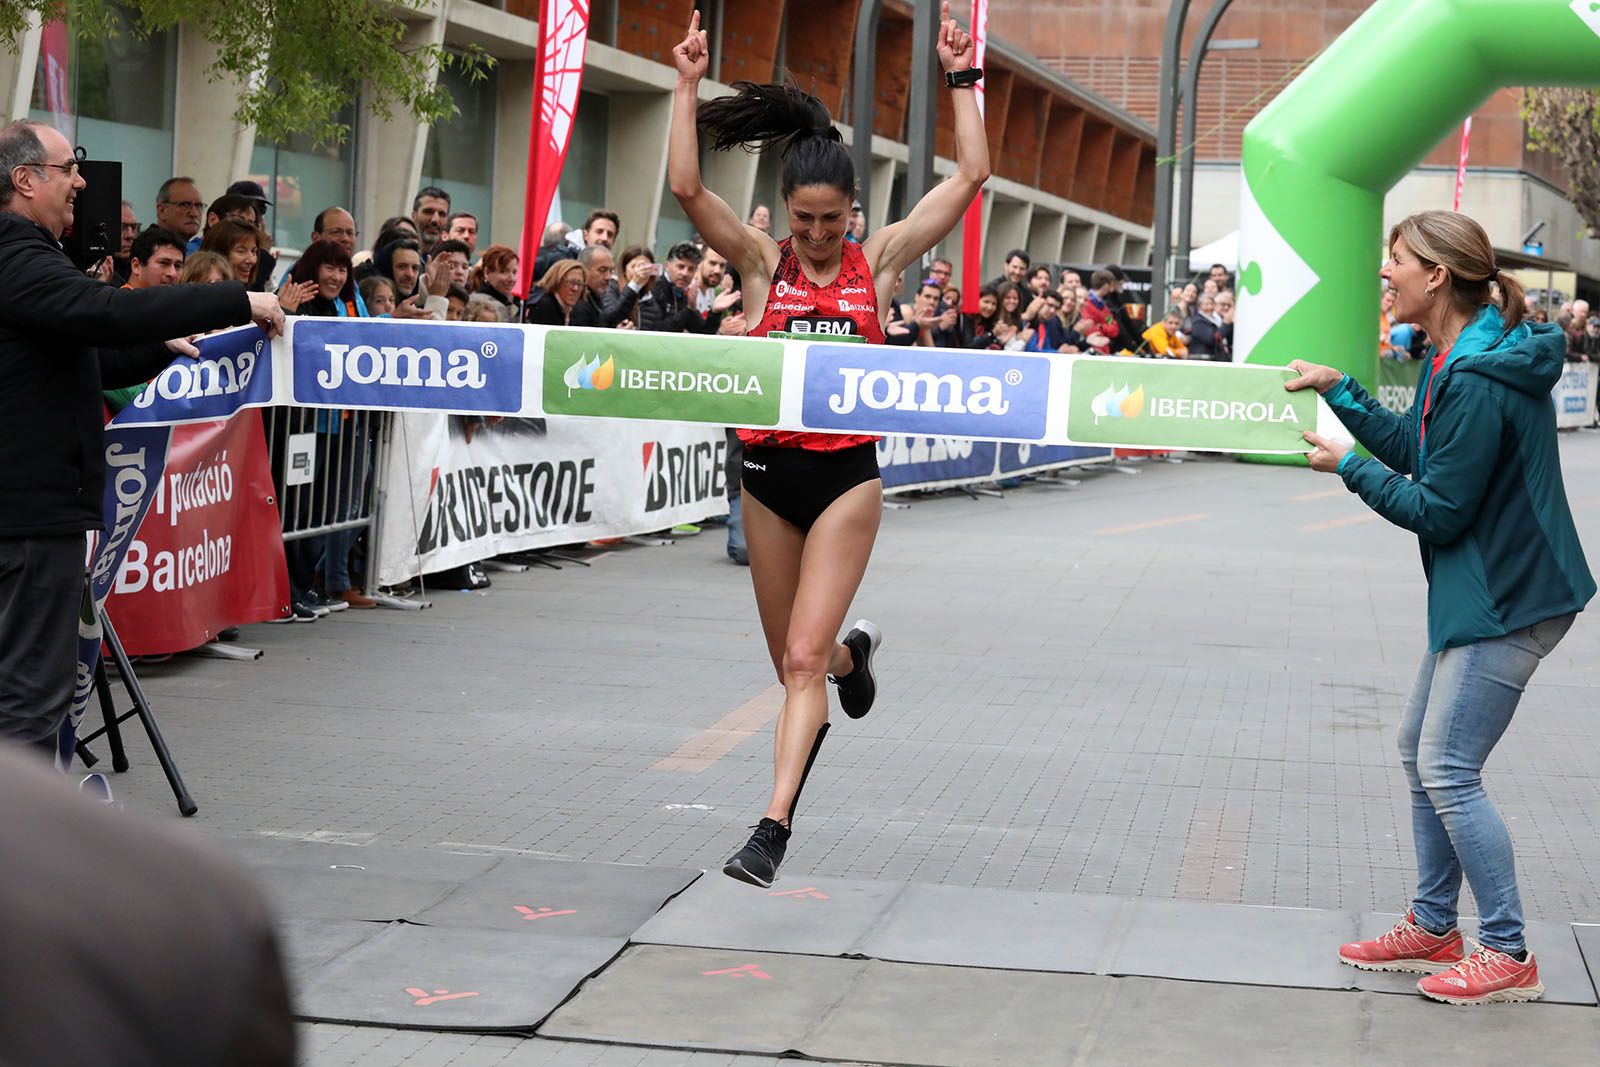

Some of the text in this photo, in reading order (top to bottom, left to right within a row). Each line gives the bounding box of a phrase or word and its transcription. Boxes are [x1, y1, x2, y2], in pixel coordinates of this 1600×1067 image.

[776, 280, 808, 298] Bilbao
[816, 321, 851, 335] BM
[620, 368, 764, 396] IBERDROLA
[1150, 397, 1299, 424] IBERDROLA
[156, 450, 233, 526] iputació
[415, 458, 595, 556] BRIDGESTONE
[114, 529, 232, 594] Barcelona
